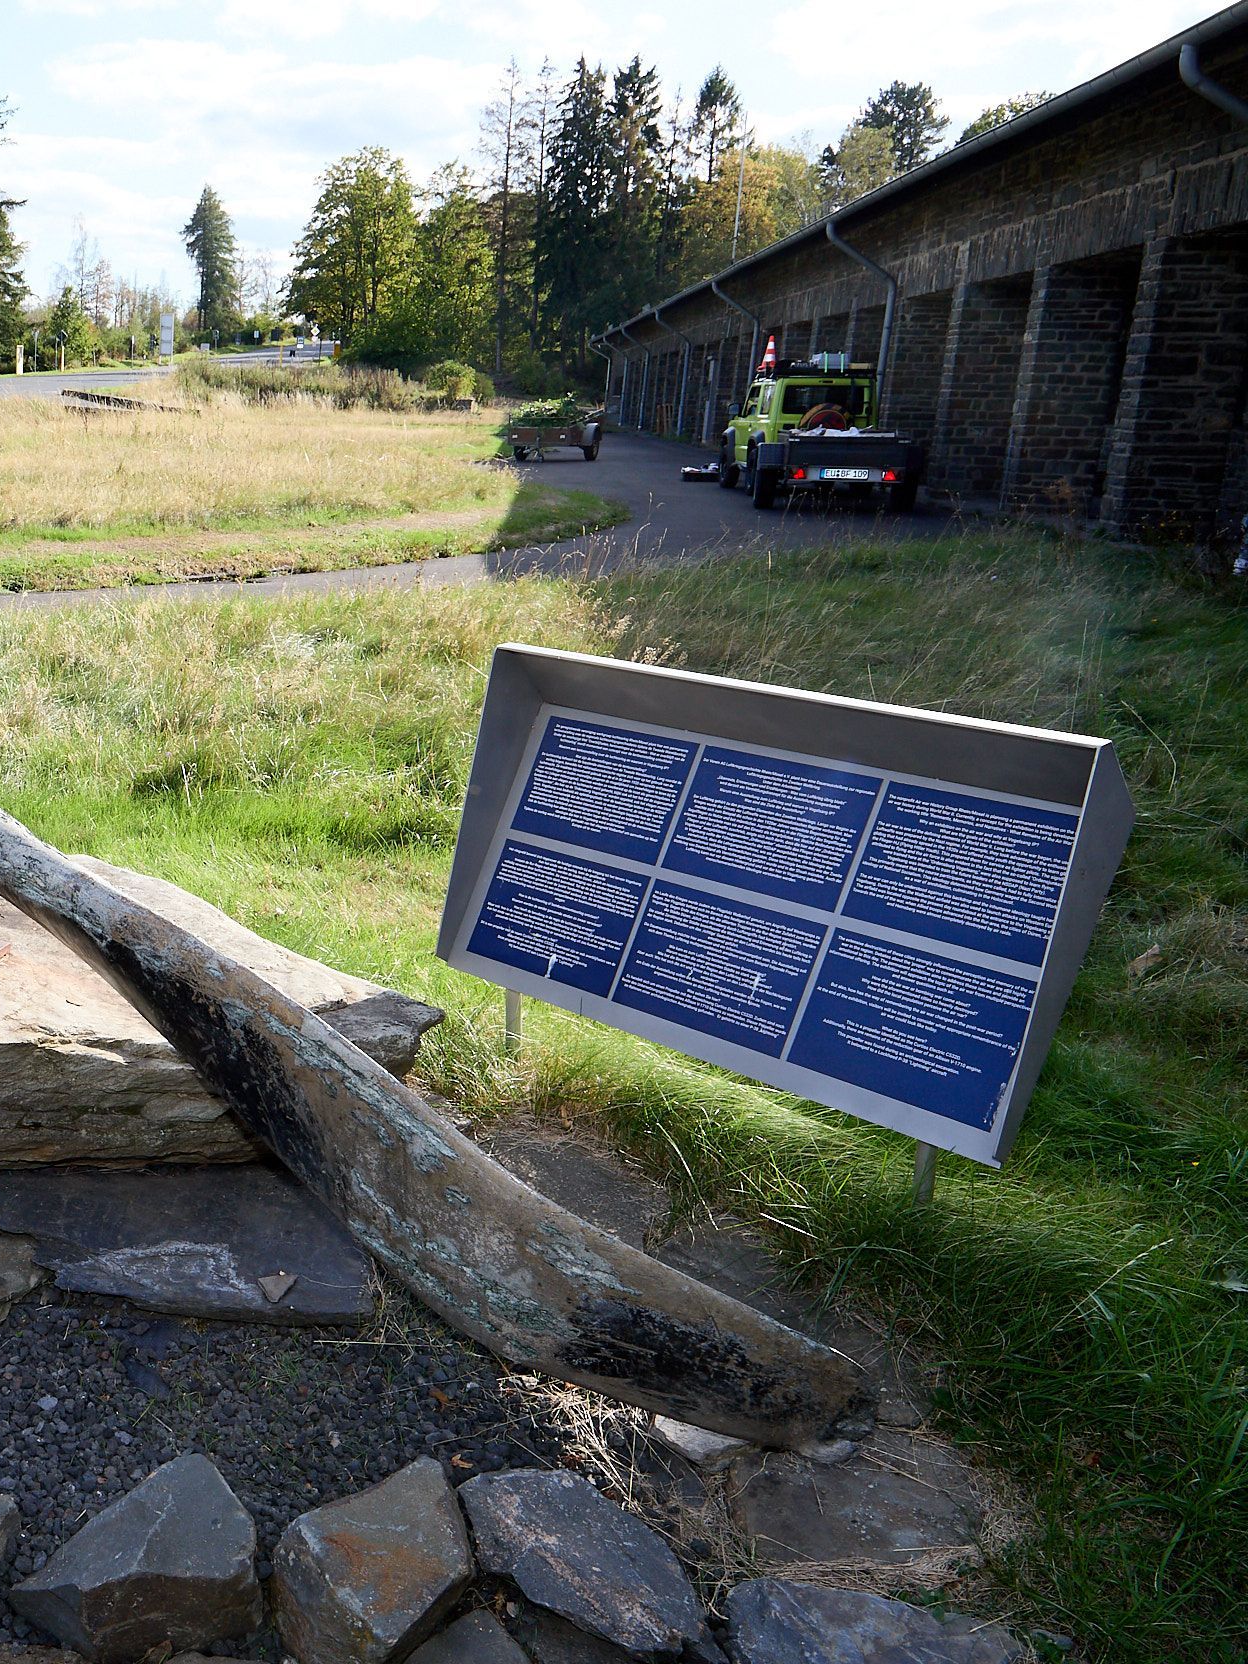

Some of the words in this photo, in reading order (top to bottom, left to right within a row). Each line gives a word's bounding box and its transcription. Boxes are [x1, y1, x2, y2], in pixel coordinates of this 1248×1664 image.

[852, 470, 868, 478] 109
[1008, 838, 1031, 846] Vogelsang
[915, 981, 936, 989] questions
[915, 988, 934, 998] bombing
[888, 986, 920, 998] aforementioned
[938, 1001, 954, 1009] heavily
[954, 1006, 978, 1016] destroyed?
[901, 996, 924, 1005] population
[885, 1000, 912, 1011] remembering
[934, 1015, 954, 1023] changed
[966, 1024, 986, 1033] post-war
[946, 1027, 971, 1037] appropriate
[971, 1035, 1002, 1047] remembrance
[851, 1041, 870, 1050] belonged
[881, 1031, 900, 1040] identified
[929, 1047, 945, 1055] Electric
[893, 1042, 913, 1050] reduction
[885, 1047, 899, 1055] during
